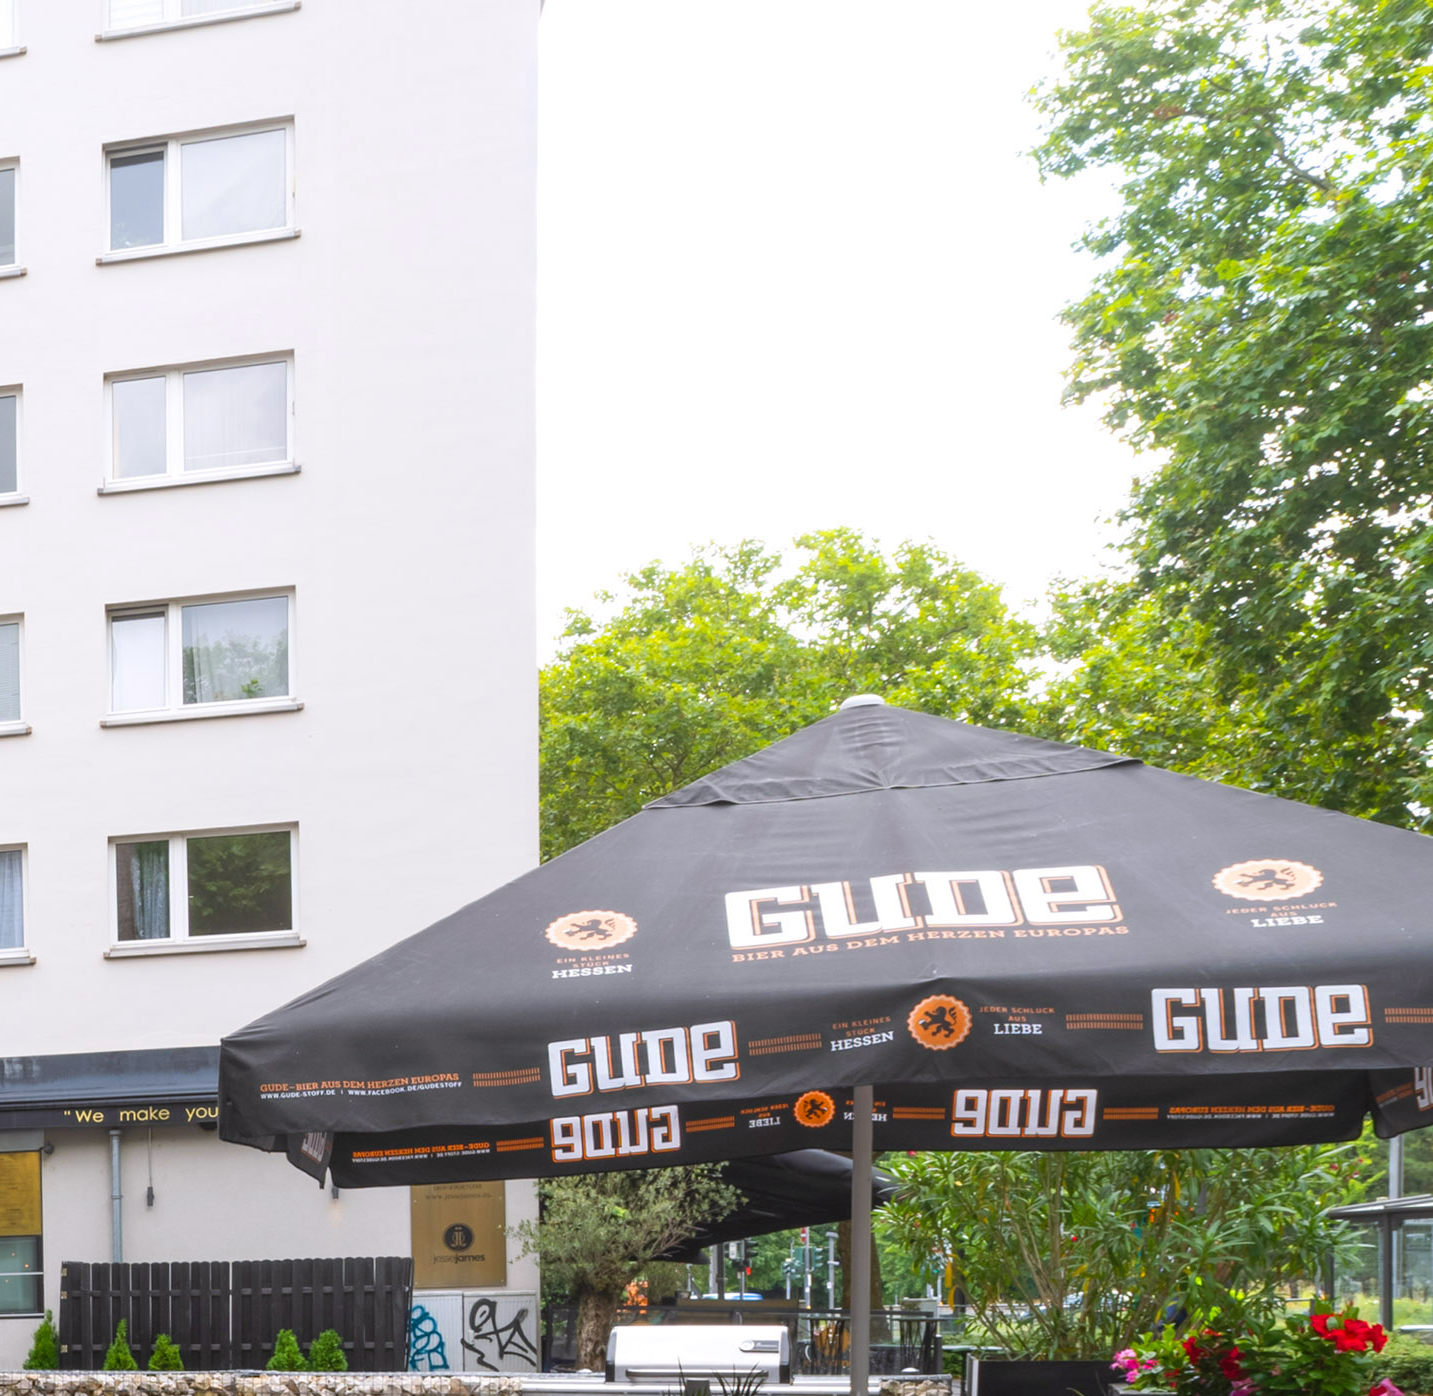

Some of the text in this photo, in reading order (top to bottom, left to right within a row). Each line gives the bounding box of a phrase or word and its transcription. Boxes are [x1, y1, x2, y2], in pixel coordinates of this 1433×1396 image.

[1272, 901, 1338, 912] SCHLUCK
[1250, 914, 1325, 928] LIEBE
[732, 925, 1130, 963] BIER AUS DEM HERZEN EUROPAS
[580, 953, 630, 962] KLEINES
[551, 964, 633, 979] HESSEN
[979, 1006, 1055, 1014] JEDER SCHLUCK
[832, 1016, 892, 1030] EIN KLEINES
[993, 1023, 1043, 1035] LIEBE
[830, 1030, 895, 1052] HESSEN
[321, 1080, 342, 1089] AUS
[343, 1080, 366, 1089] DEM
[367, 1077, 409, 1089] HERZEN
[411, 1073, 460, 1085] EUROPAS
[119, 1106, 170, 1122] make
[185, 1106, 219, 1122] you
